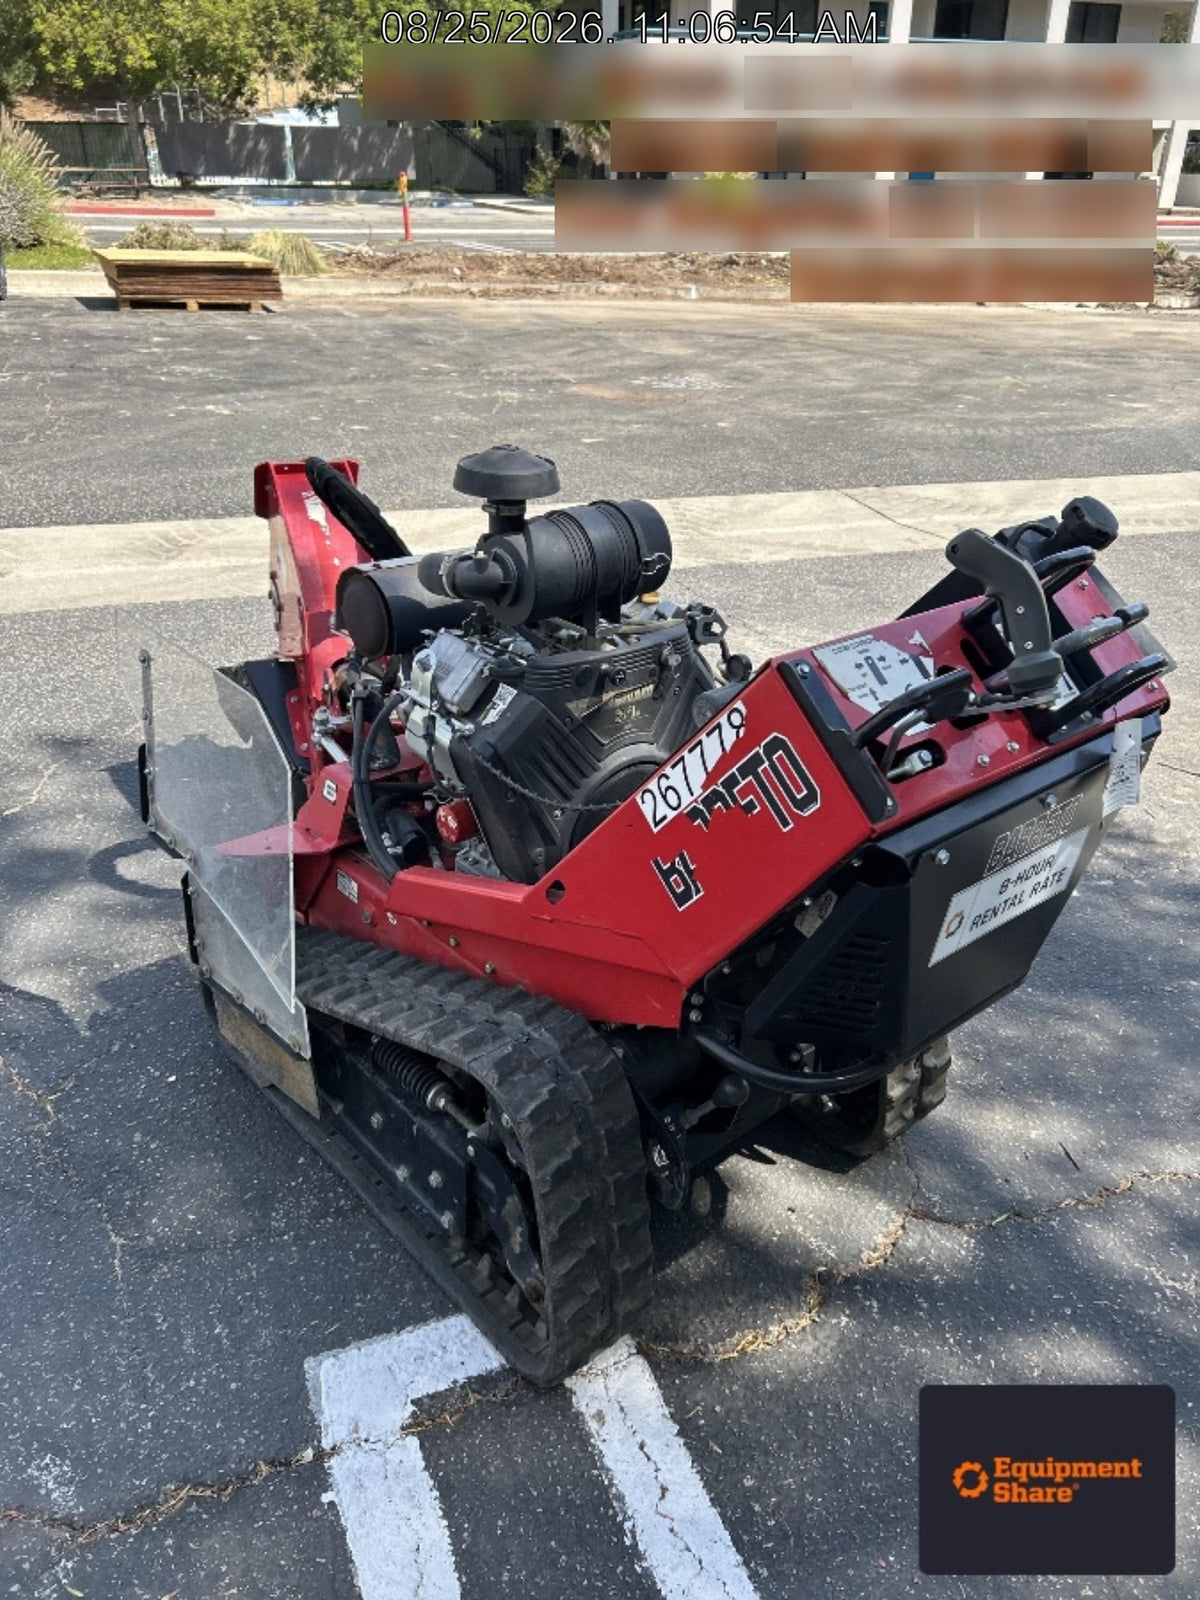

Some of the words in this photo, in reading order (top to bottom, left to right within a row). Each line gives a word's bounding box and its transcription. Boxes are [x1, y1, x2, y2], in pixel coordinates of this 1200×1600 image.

[969, 890, 1025, 932] RENTAL
[1029, 867, 1068, 898] RATE
[999, 853, 1056, 895] 8-HOUR
